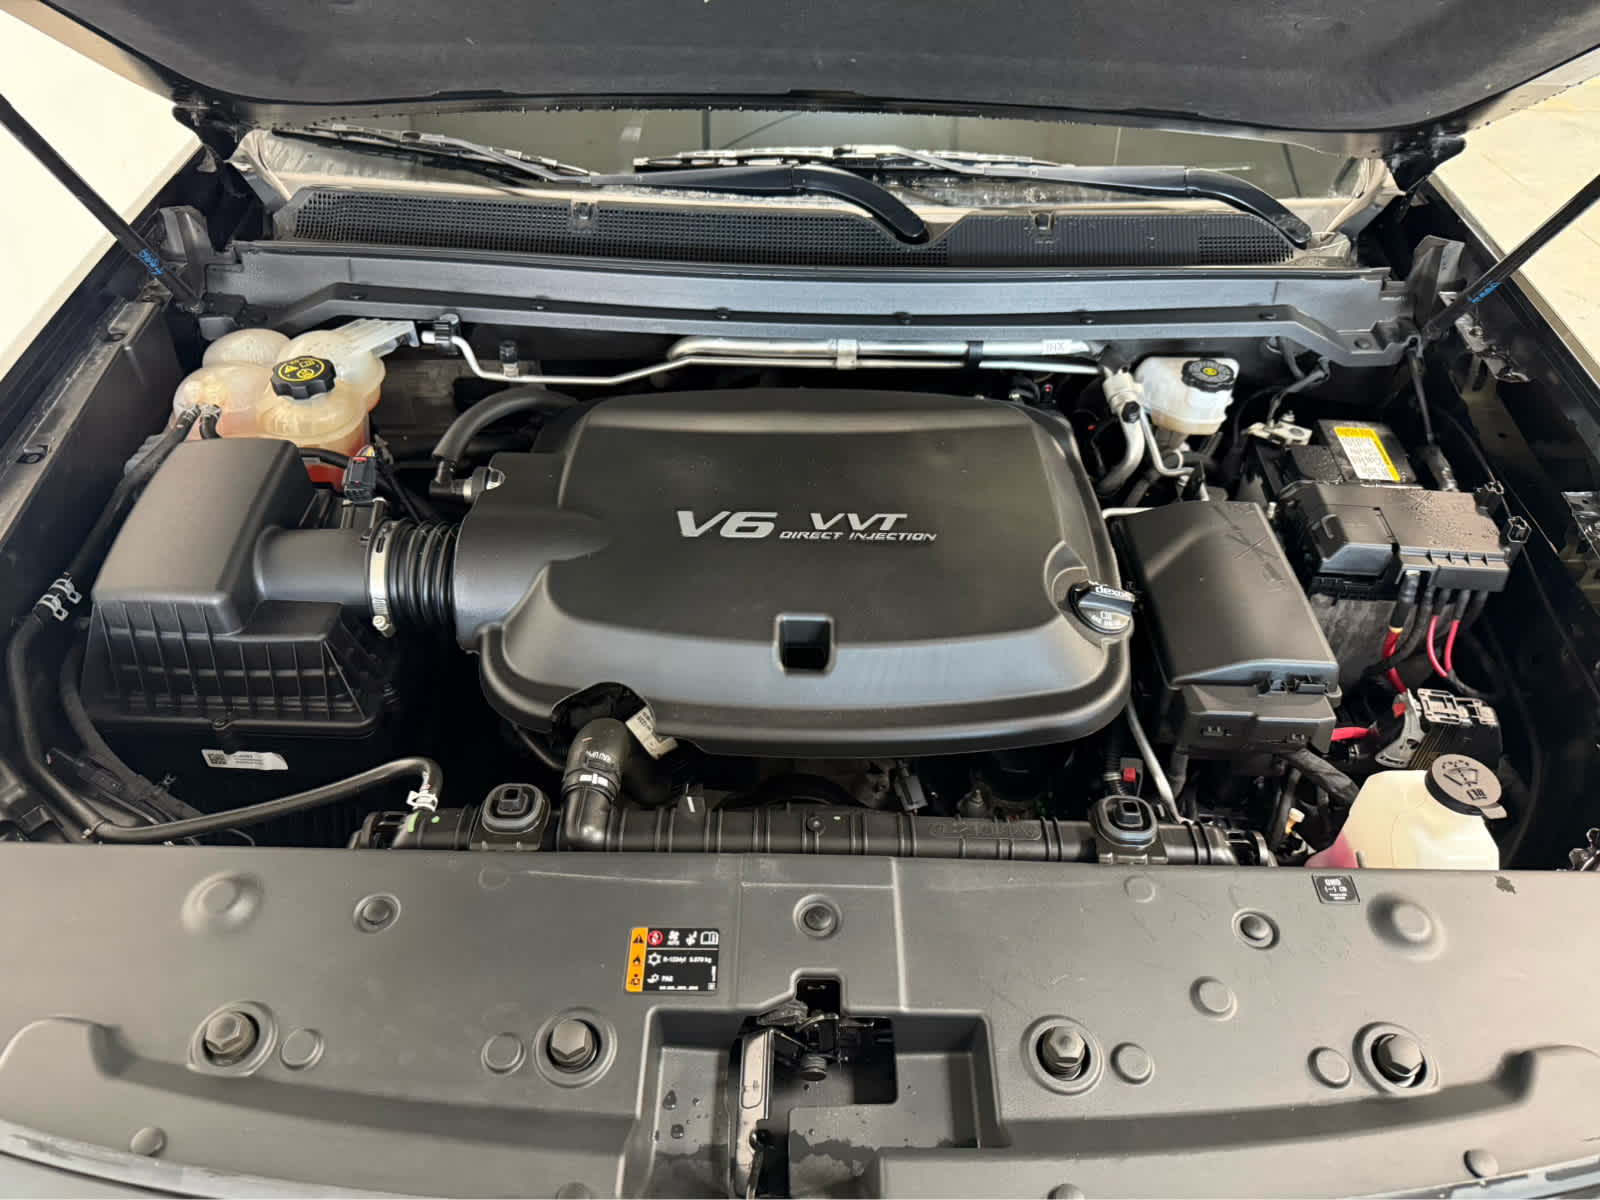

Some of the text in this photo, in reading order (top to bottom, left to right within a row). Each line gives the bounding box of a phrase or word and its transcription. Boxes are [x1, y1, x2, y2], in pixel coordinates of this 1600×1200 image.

[677, 510, 909, 539] V6 VVT
[779, 531, 938, 542] DIRECT INJECTION
